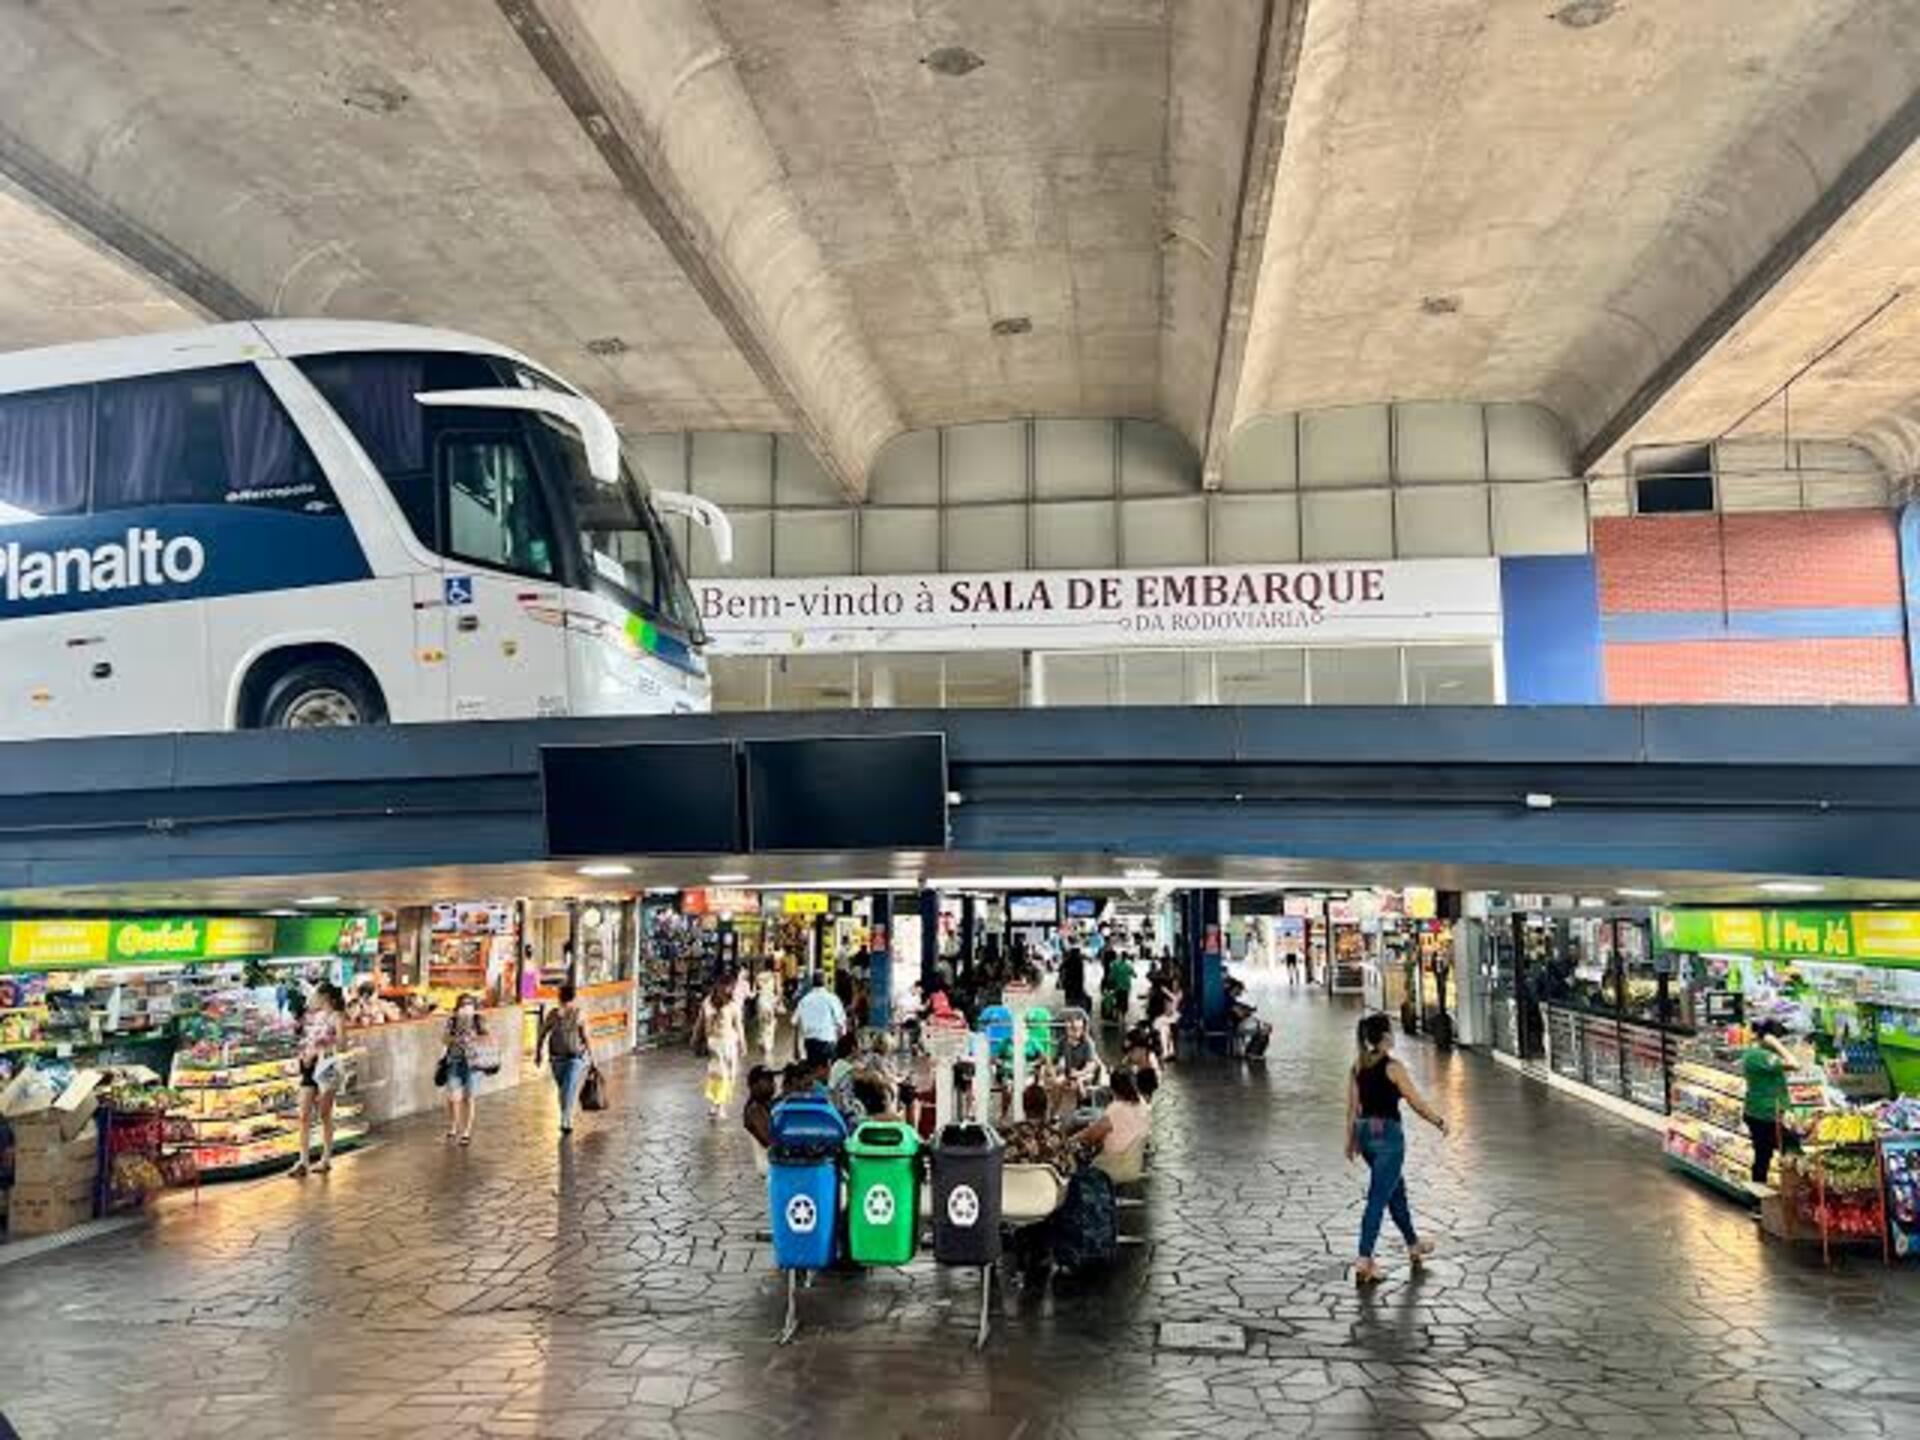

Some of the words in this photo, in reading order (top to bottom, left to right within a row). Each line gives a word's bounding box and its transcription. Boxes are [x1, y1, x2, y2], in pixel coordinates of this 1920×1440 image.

[0, 527, 205, 601] lanalto
[701, 584, 904, 619] Bem-vindo
[914, 581, 935, 614] à
[950, 578, 1054, 613] SALA
[1067, 578, 1123, 610] DE
[1136, 568, 1386, 611] EMBARQUE
[1135, 613, 1166, 632] DA
